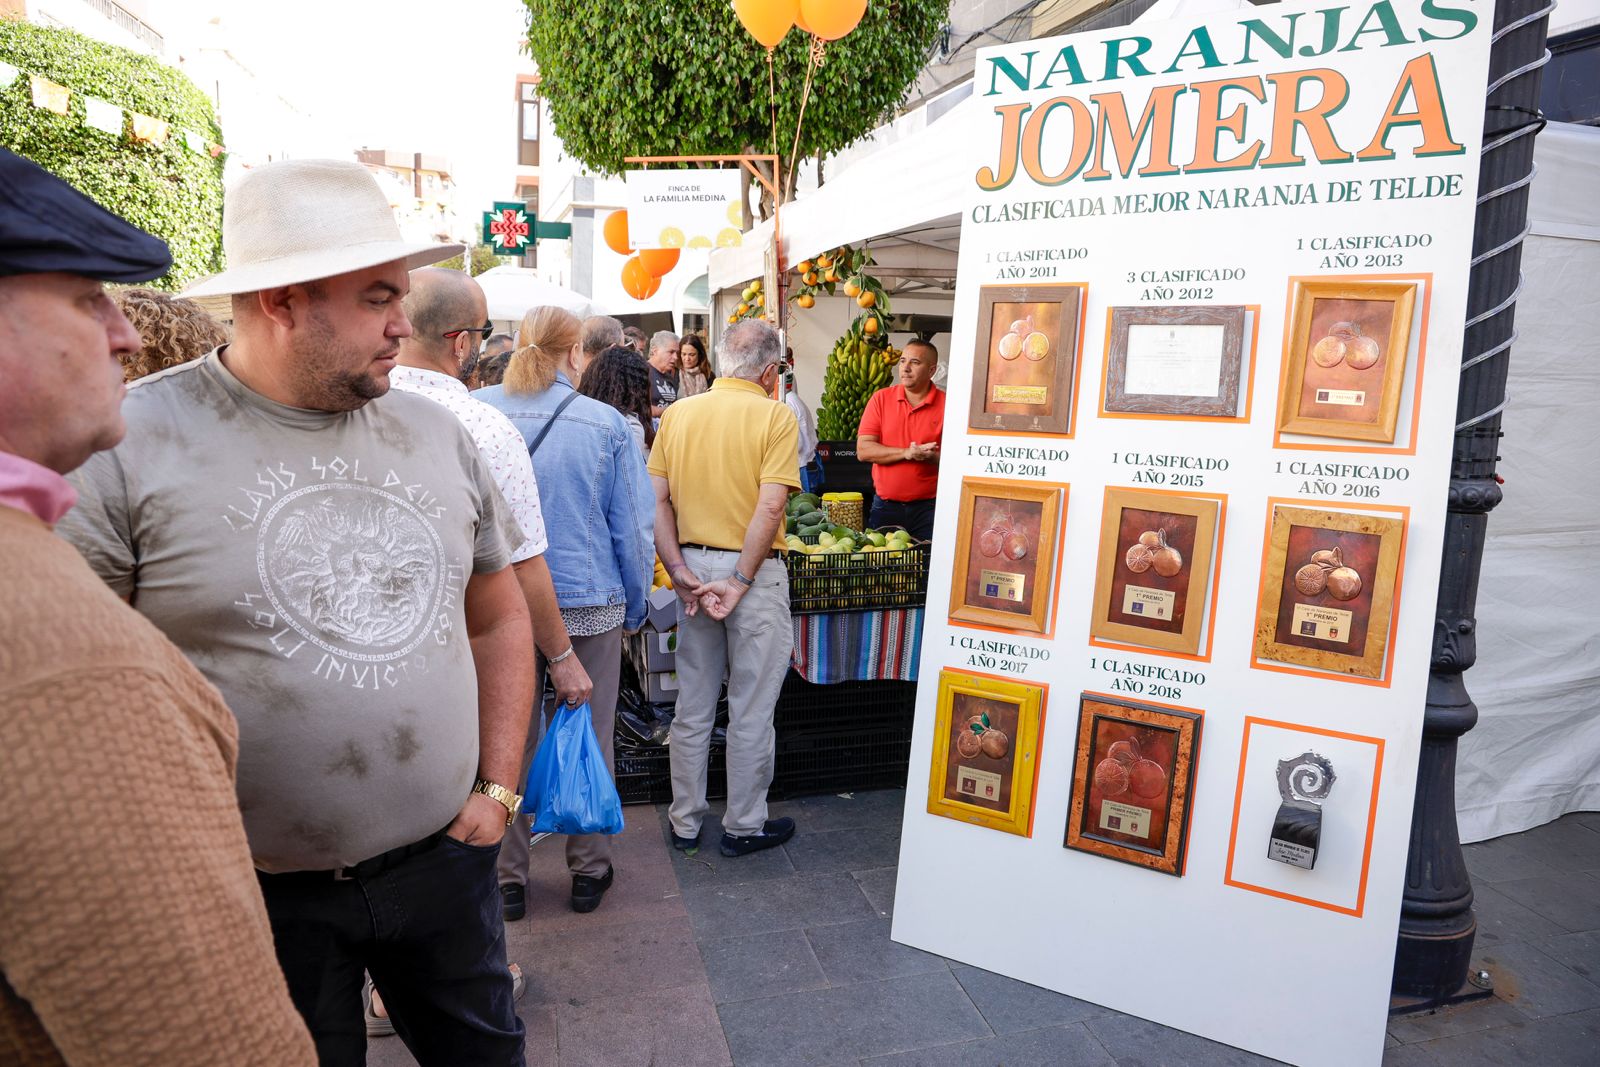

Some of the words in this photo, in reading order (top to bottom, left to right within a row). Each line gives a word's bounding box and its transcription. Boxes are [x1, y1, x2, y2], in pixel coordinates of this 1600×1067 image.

[982, 0, 1478, 96] NARANJAS
[975, 52, 1467, 192] JOMERA
[643, 195, 654, 203] LA
[692, 194, 726, 202] MEDINA
[972, 196, 1106, 224] CLASIFICADA
[1113, 191, 1190, 215] MEJOR
[1197, 182, 1318, 209] NARANJA
[1326, 180, 1362, 203] DE
[1369, 174, 1463, 201] TELDE
[1297, 238, 1303, 251] 1
[1310, 233, 1433, 250] CLASIFICADO
[996, 247, 1088, 263] CLASIFICADO
[1319, 253, 1359, 269] AÑO
[1364, 254, 1403, 268] 2013
[996, 266, 1026, 279] AÑO
[1029, 266, 1058, 278] 2011
[1127, 272, 1136, 284] 3
[1140, 268, 1246, 283] CLASIFICADO
[1140, 285, 1174, 301] AÑO
[1178, 287, 1214, 300] 2012
[967, 445, 973, 457] 1
[978, 445, 1069, 462] CLASIFICADO
[1111, 452, 1118, 464] 1
[1124, 452, 1229, 472] CLASIFICADO
[984, 460, 1014, 475] AÑO
[1018, 464, 1047, 477] 2014
[1132, 468, 1166, 484] AÑO
[1170, 473, 1205, 488] 2015
[1274, 461, 1282, 474] 1
[1289, 461, 1410, 481] CLASIFICADO
[311, 456, 368, 482] SOL
[382, 469, 447, 521] DEUS
[1298, 478, 1337, 496] AÑO
[1342, 483, 1381, 498] 2016
[949, 635, 955, 647] 1
[960, 636, 1051, 661] CLASIFICADO
[967, 653, 996, 669] AÑO
[1000, 658, 1029, 674] 2017
[1090, 658, 1097, 670] 1
[1102, 658, 1206, 685] CLASIFICADO
[1110, 676, 1144, 694] AÑO
[1148, 683, 1182, 700] 2018
